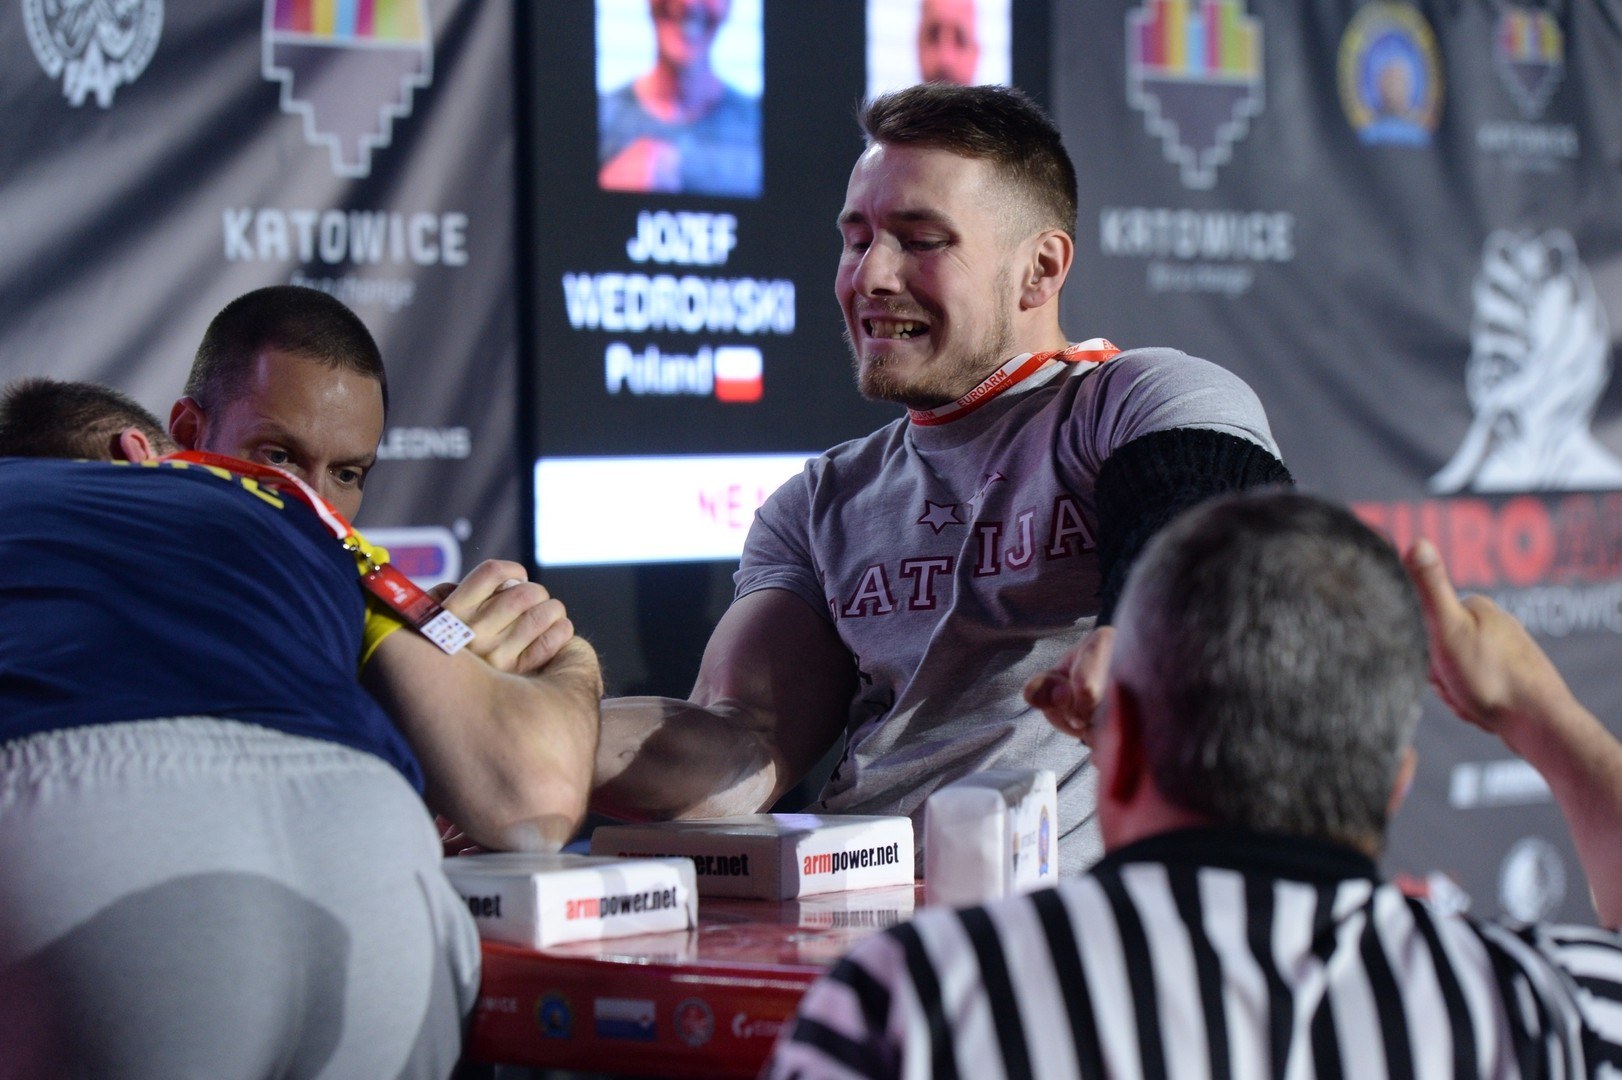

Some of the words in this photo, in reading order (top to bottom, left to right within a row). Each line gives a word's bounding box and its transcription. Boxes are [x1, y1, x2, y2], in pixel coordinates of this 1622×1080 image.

[222, 207, 469, 266] KATOWICE
[627, 210, 737, 264] JOZEF
[1100, 206, 1295, 262] KATOWICE
[562, 272, 796, 335] WEDROWSKI
[605, 342, 714, 396] Poland
[957, 369, 1009, 408] EUROARM
[803, 842, 899, 876] armpower.net
[566, 886, 677, 920] armpower.net
